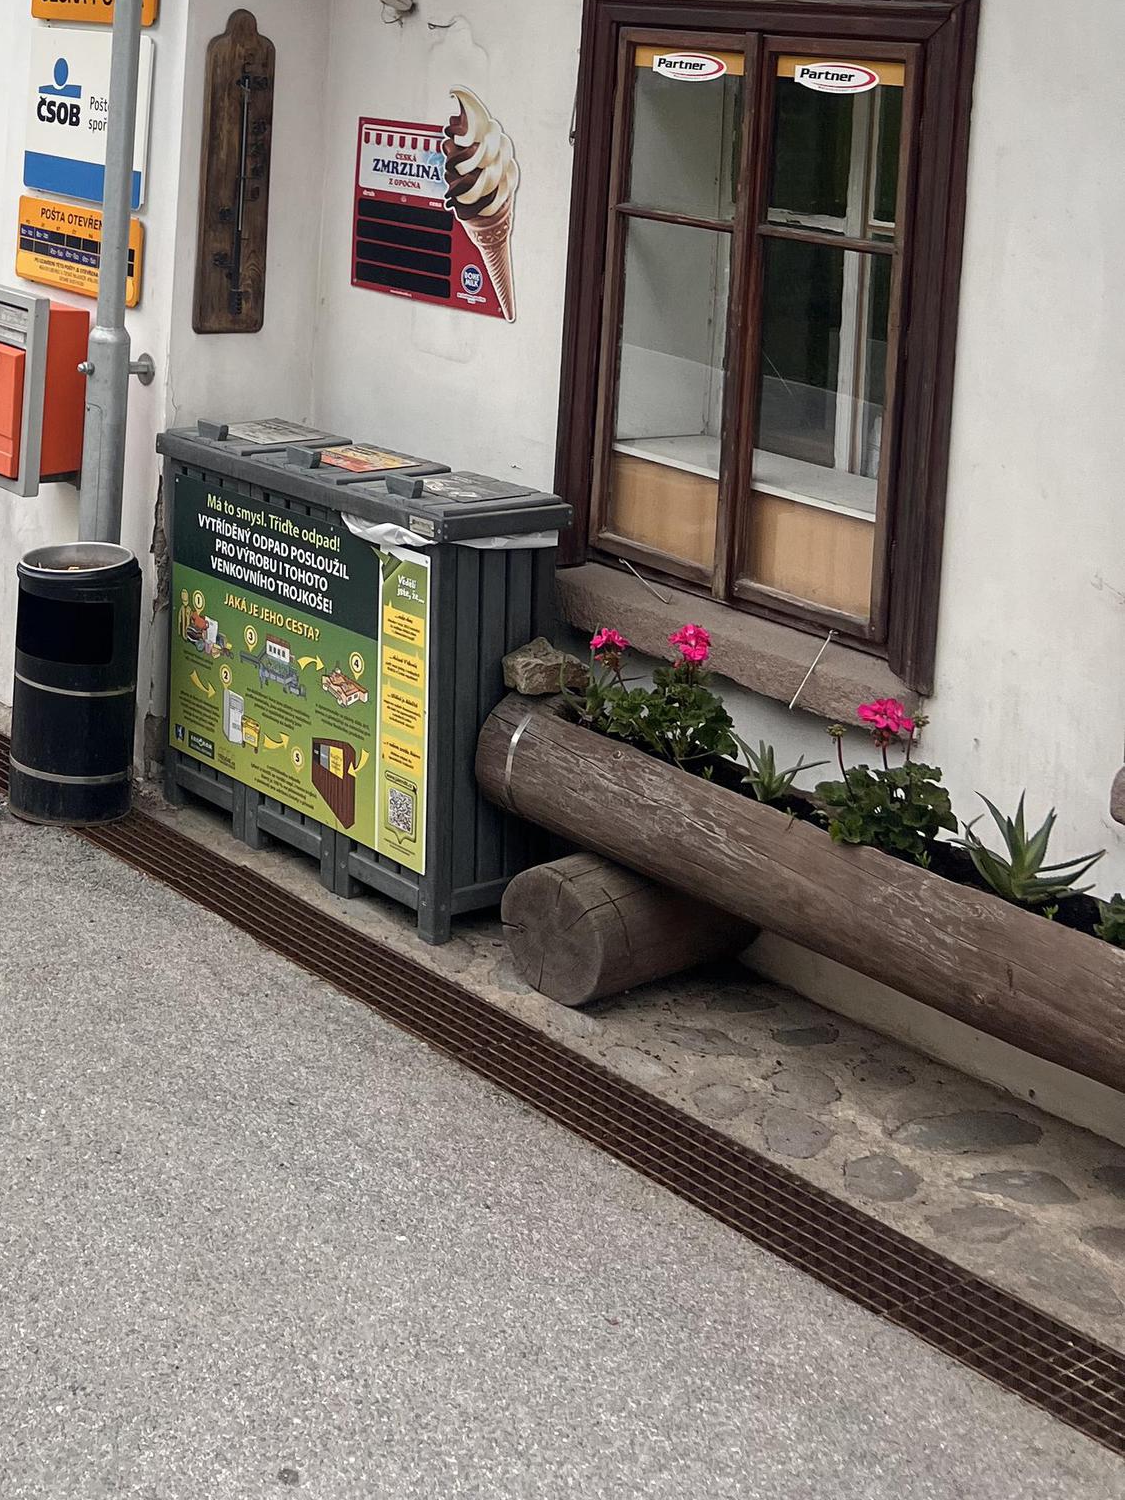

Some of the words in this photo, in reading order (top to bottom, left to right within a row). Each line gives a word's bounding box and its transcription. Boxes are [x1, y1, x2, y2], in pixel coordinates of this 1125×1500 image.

[657, 57, 706, 71] Partner
[799, 67, 855, 83] Partner
[37, 96, 81, 127] ČSOB
[89, 96, 110, 112] Pošt
[88, 117, 108, 134] spoř
[372, 158, 441, 181] ZMRZLINA
[395, 150, 417, 162] ČESKÁ
[40, 206, 66, 223] POŠTA
[207, 493, 222, 511] Má
[224, 500, 235, 515] to
[236, 506, 268, 527] smysl.
[268, 514, 300, 538] Třiďte
[301, 528, 341, 552] odpad!
[198, 513, 252, 544] VYTŘÍDĚNÝ
[252, 533, 289, 557] ODPAD
[290, 546, 350, 580] POSLOUŽIL
[215, 539, 235, 557] PRO
[236, 547, 278, 573] VÝROBU
[278, 562, 283, 575] I
[283, 564, 328, 592] TOHOTO
[210, 555, 275, 592] VENKOVNÍHO
[276, 580, 333, 615] TROJKOŠE!
[223, 593, 248, 613] JAKÁ
[248, 603, 259, 617] JE
[259, 607, 284, 627] JEHO
[285, 617, 321, 641] CESTA?
